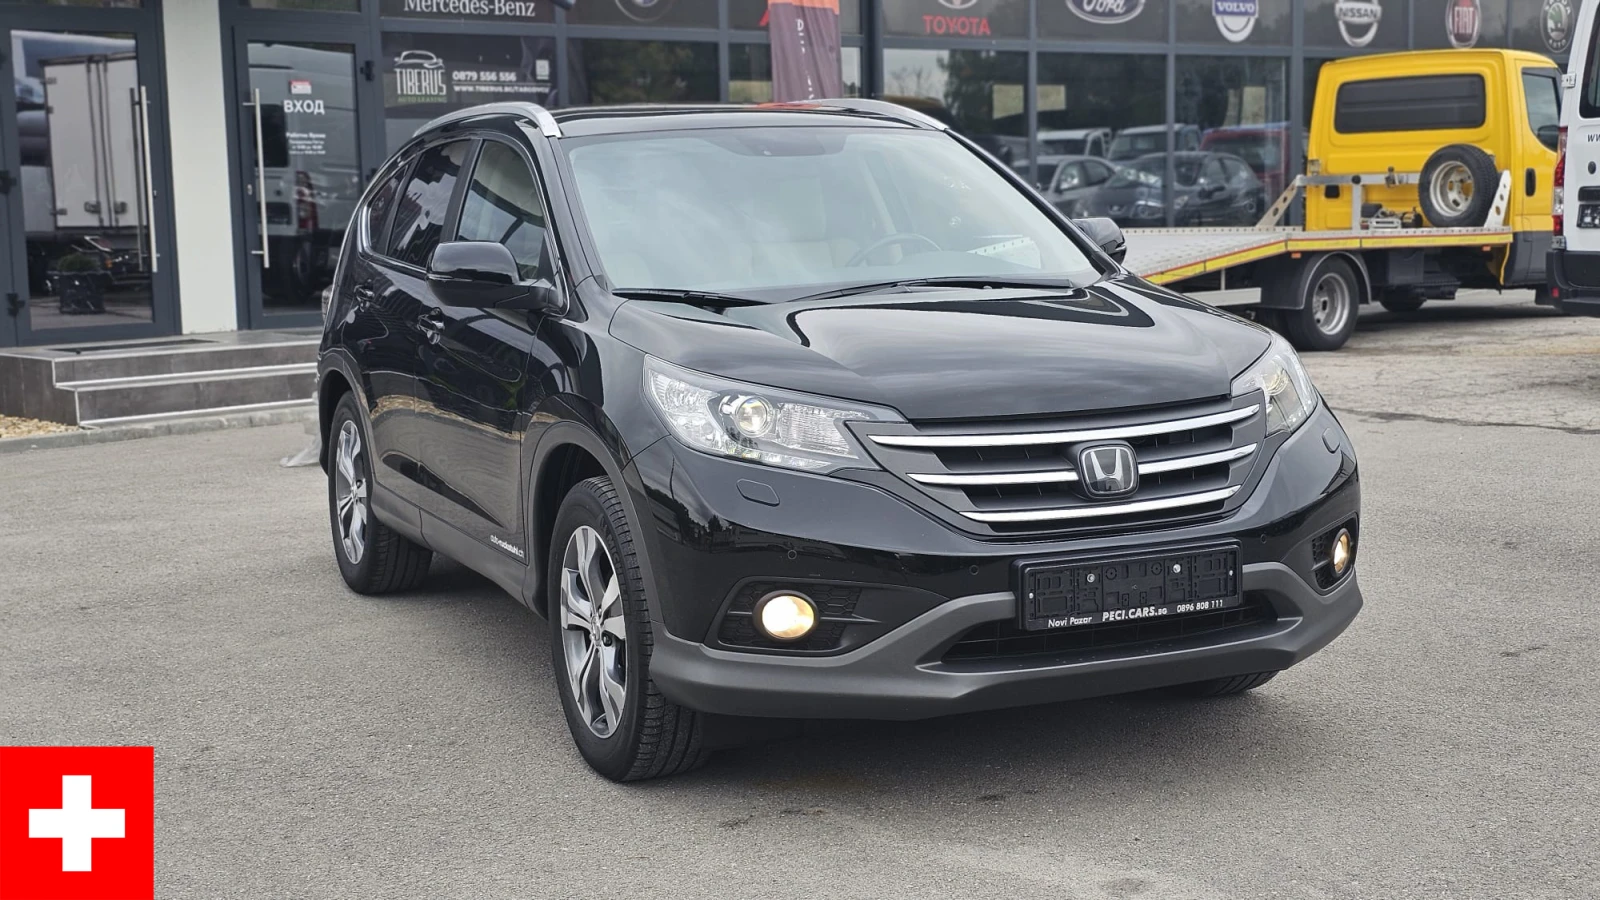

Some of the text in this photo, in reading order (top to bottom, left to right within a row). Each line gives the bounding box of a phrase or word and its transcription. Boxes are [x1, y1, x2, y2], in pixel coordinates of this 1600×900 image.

[404, 0, 536, 17] Mercedes-Benz
[1216, 1, 1255, 13] VOLVO
[1338, 7, 1378, 20] NISSAN
[923, 14, 990, 35] TOYOTA
[1454, 6, 1475, 34] FIAT
[394, 68, 447, 95] TIBERUS
[452, 70, 517, 82] 0879 556 556
[284, 99, 325, 115] ВХОД
[1048, 618, 1067, 628] Novi
[1069, 616, 1093, 626] Pazar
[1176, 603, 1194, 613] 0896
[1196, 601, 1209, 610] 808
[1211, 599, 1223, 608] 111
